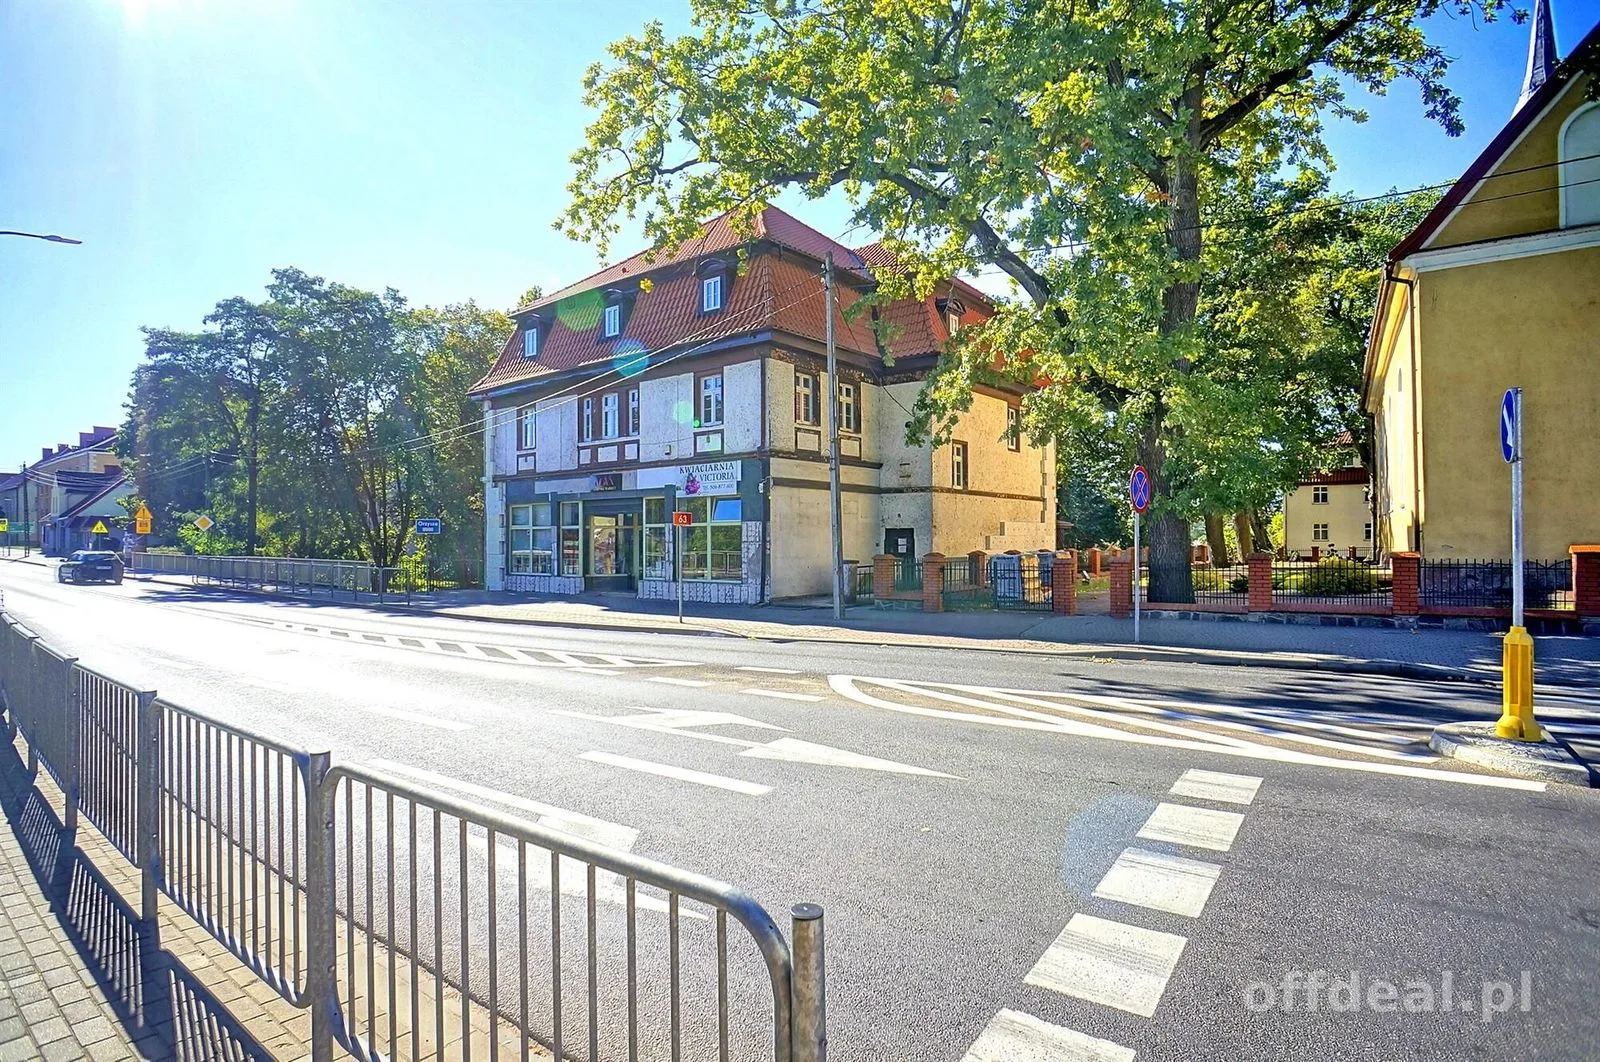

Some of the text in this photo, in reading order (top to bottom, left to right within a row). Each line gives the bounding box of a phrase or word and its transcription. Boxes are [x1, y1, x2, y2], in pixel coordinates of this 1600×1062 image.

[680, 462, 734, 475] KWIACIARNIA
[700, 472, 735, 482] VICTORIA
[679, 514, 687, 524] 63
